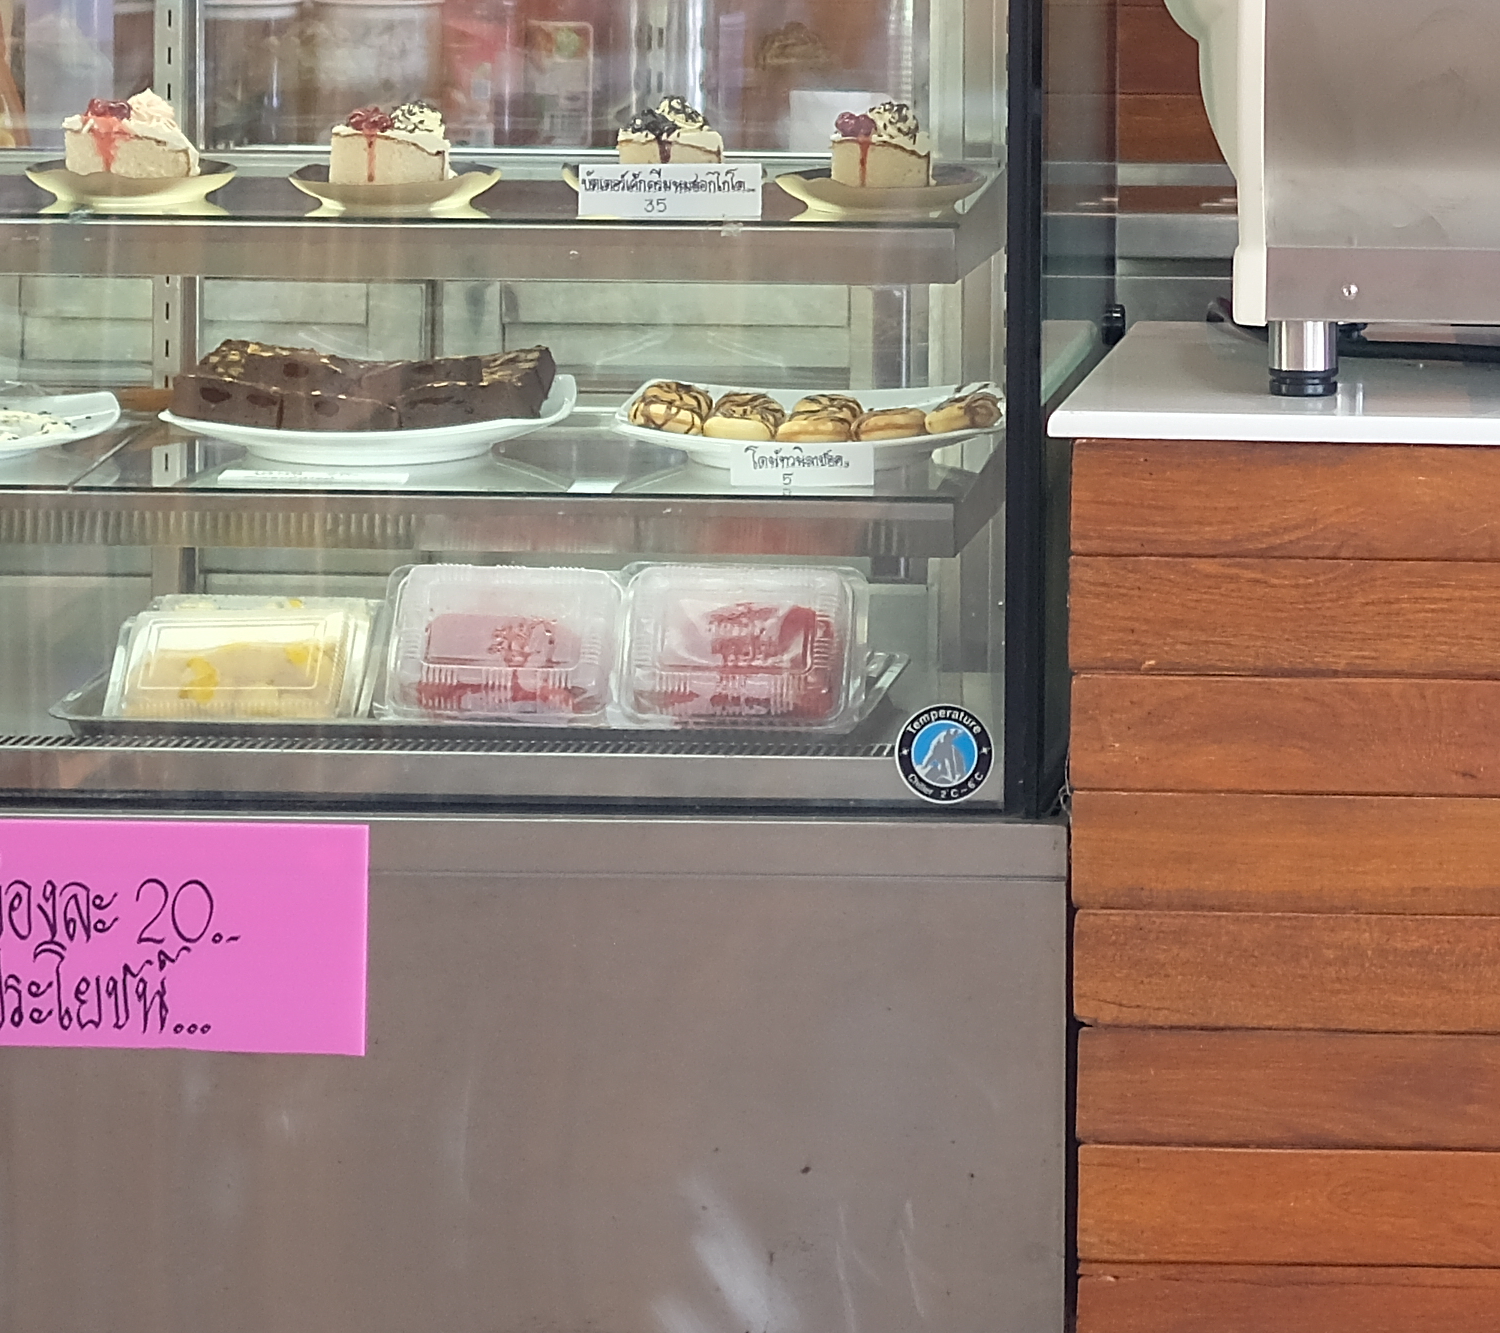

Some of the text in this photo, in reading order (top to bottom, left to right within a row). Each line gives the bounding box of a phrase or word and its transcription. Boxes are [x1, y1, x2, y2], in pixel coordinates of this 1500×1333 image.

[644, 198, 667, 213] 35
[782, 472, 793, 485] 5
[906, 709, 982, 734] Temperature
